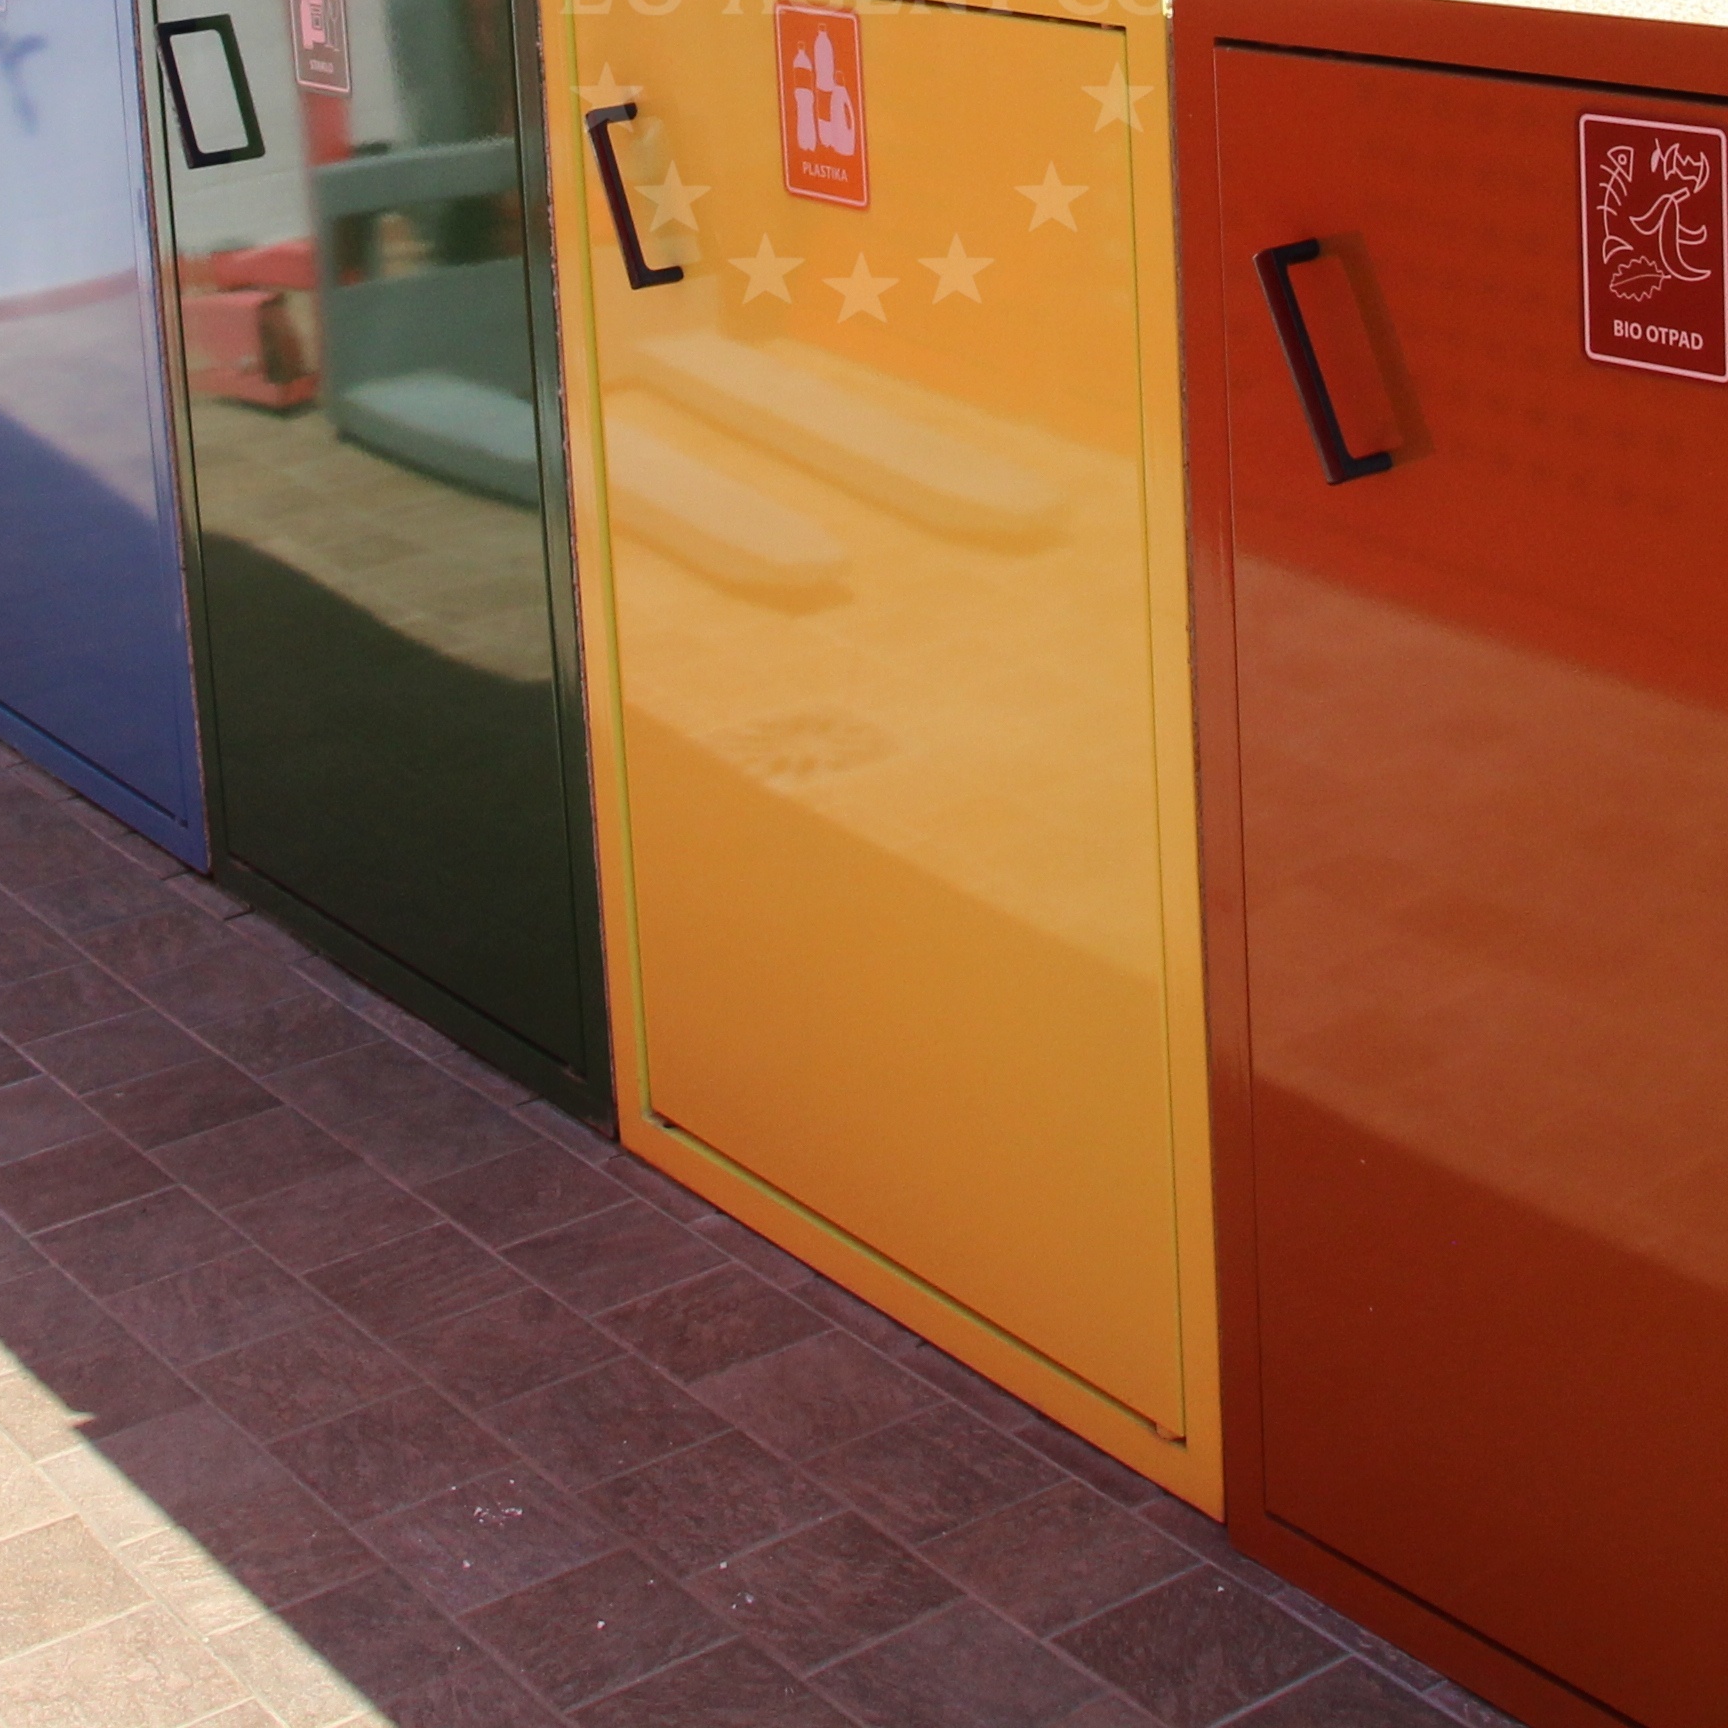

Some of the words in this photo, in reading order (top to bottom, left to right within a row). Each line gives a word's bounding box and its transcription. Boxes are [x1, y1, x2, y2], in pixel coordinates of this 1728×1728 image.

[802, 160, 849, 182] PLASTIKA
[1613, 318, 1643, 341] BIO
[1645, 323, 1704, 351] OTPAD
